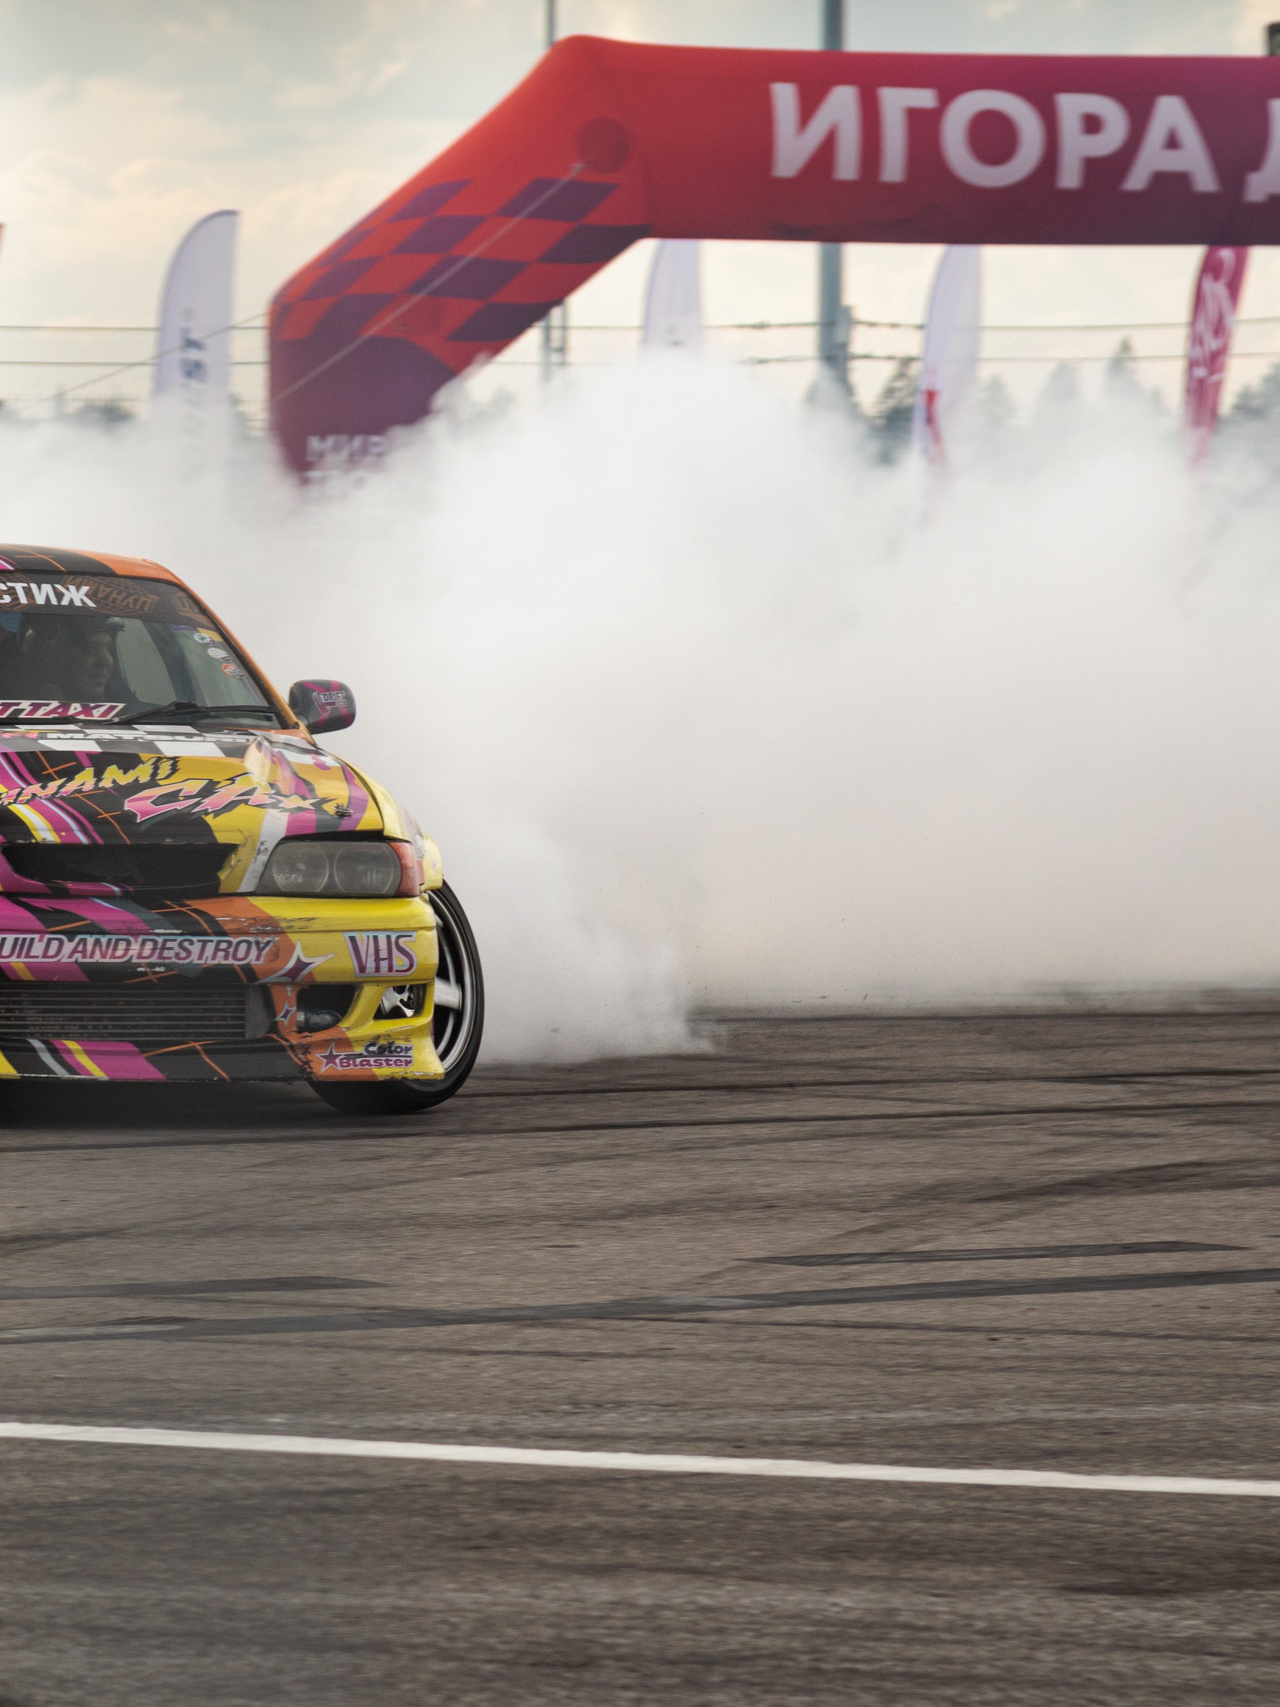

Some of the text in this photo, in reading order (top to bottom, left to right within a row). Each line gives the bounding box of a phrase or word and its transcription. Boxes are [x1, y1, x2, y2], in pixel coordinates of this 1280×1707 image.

[769, 81, 1221, 194] ИГОРА
[23, 701, 122, 719] TAXI
[67, 937, 132, 959] AND
[136, 938, 273, 962] DESTROY
[347, 934, 415, 974] VHS
[364, 1041, 413, 1055] Color
[339, 1057, 413, 1069] Blaster
